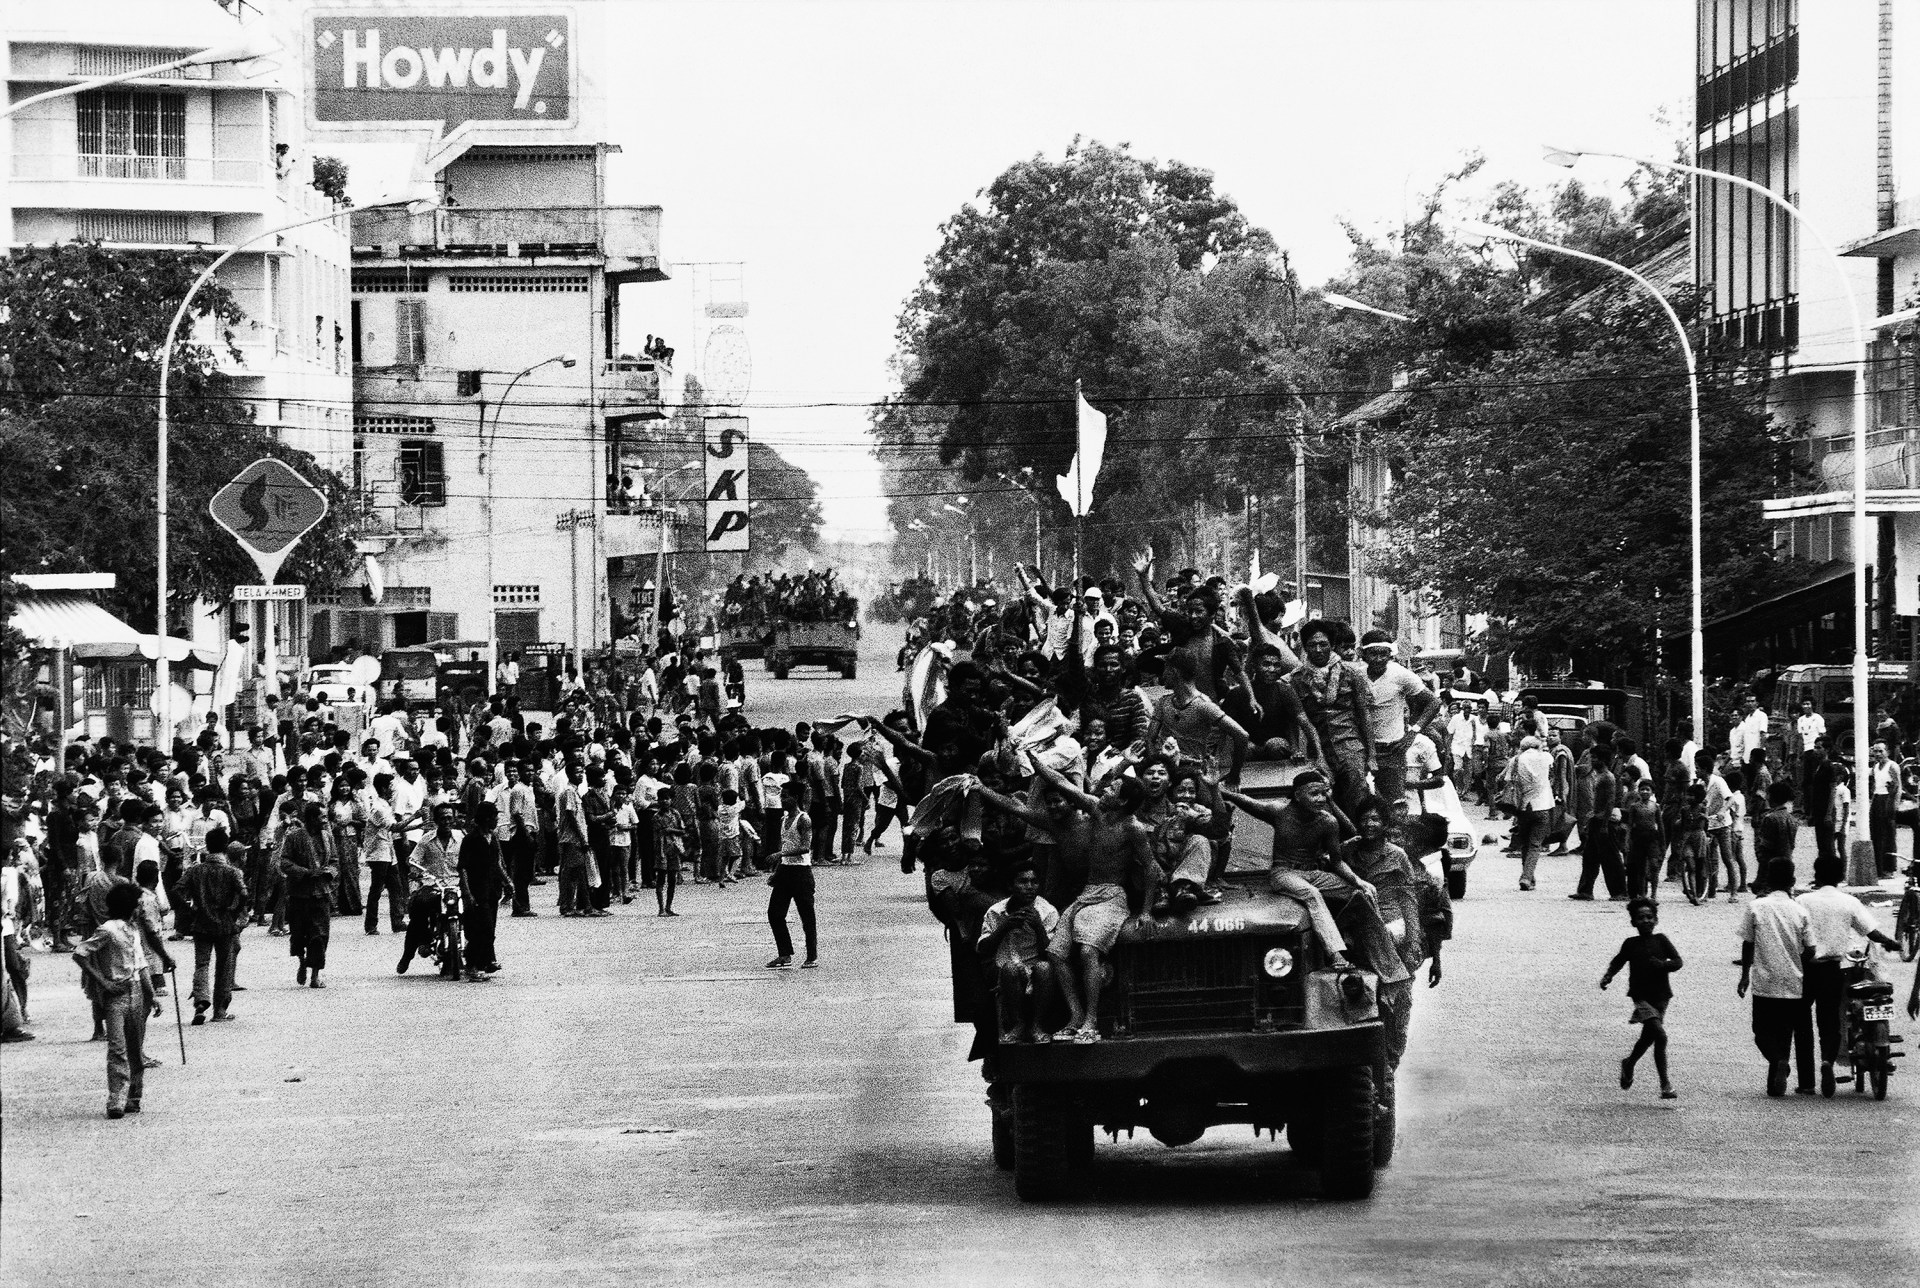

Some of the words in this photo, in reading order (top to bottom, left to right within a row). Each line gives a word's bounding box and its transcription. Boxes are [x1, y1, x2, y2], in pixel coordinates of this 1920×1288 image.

[707, 428, 749, 541] SKP
[237, 587, 262, 598] TELA
[264, 587, 302, 598] KHMER
[1187, 918, 1209, 934] 44
